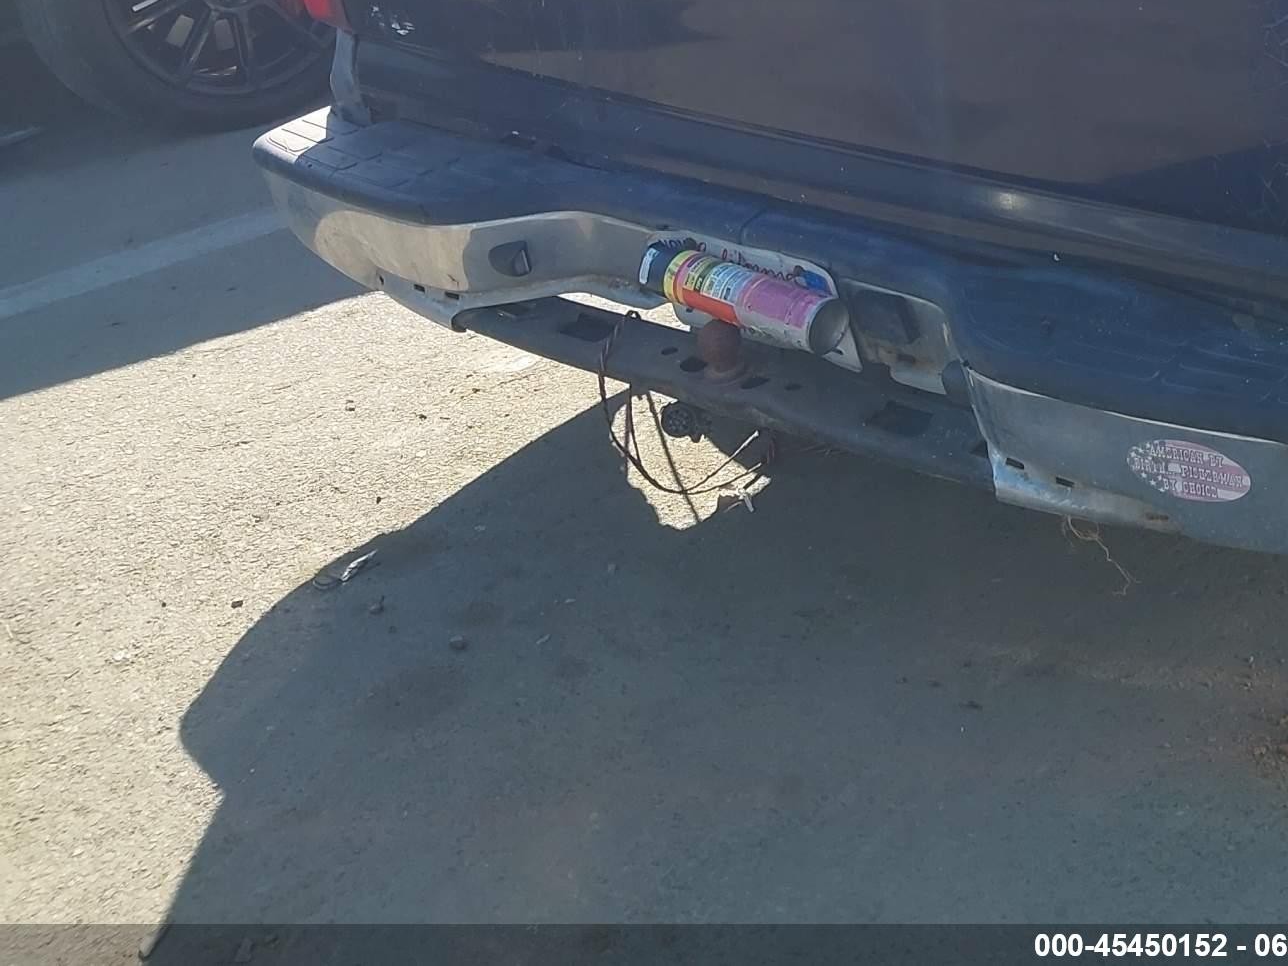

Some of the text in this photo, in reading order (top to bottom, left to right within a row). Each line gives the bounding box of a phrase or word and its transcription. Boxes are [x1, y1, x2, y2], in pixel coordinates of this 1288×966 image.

[1150, 444, 1204, 465] AMERICAN
[1163, 478, 1218, 498] BY CHOICE
